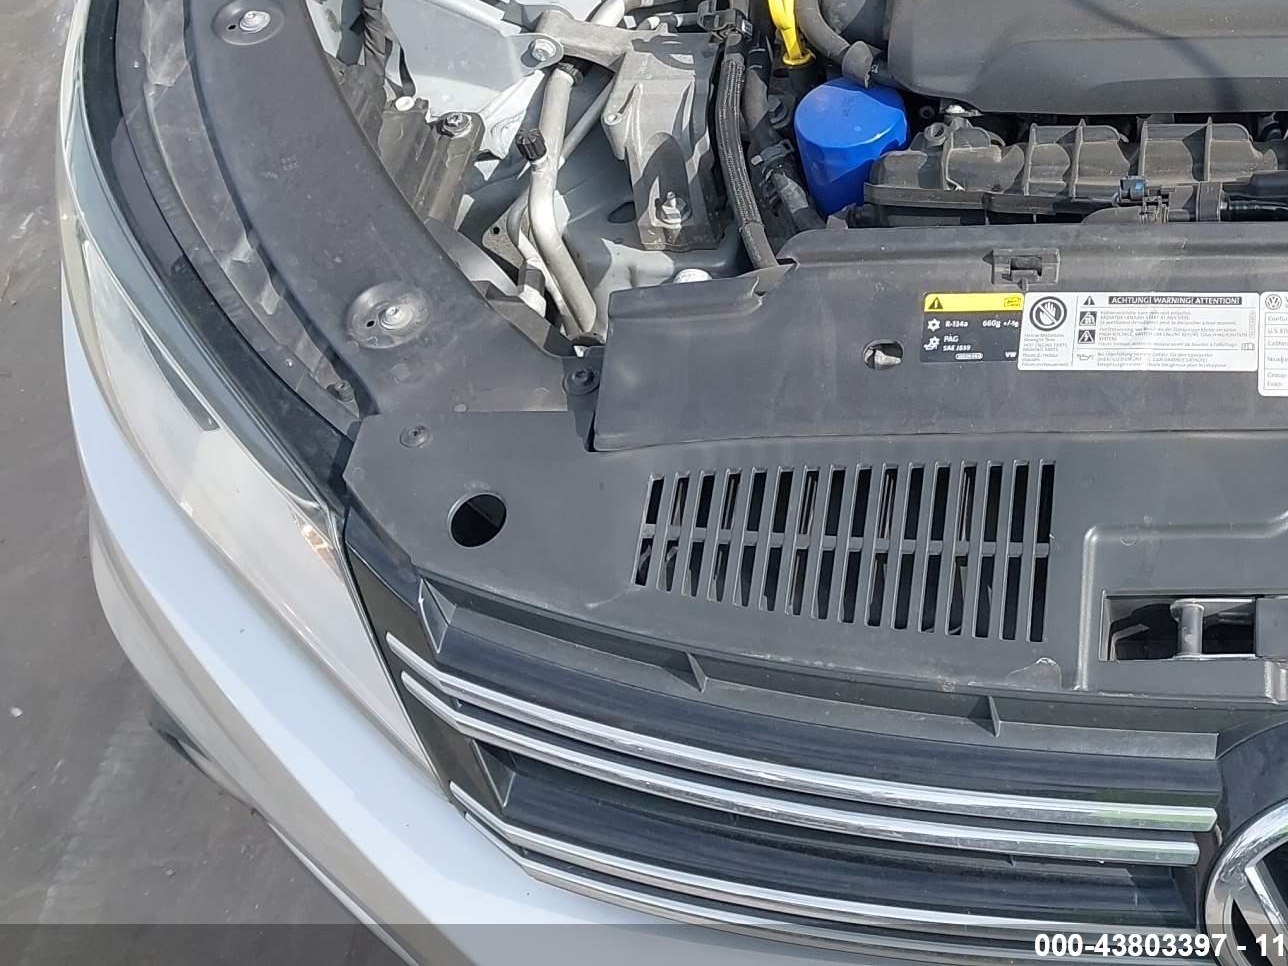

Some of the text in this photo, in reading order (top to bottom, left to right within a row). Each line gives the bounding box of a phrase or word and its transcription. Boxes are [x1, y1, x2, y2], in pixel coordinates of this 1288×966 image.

[1112, 296, 1240, 305] ACHTUNG! WARNING! ATTENTION!
[943, 335, 959, 343] PAG
